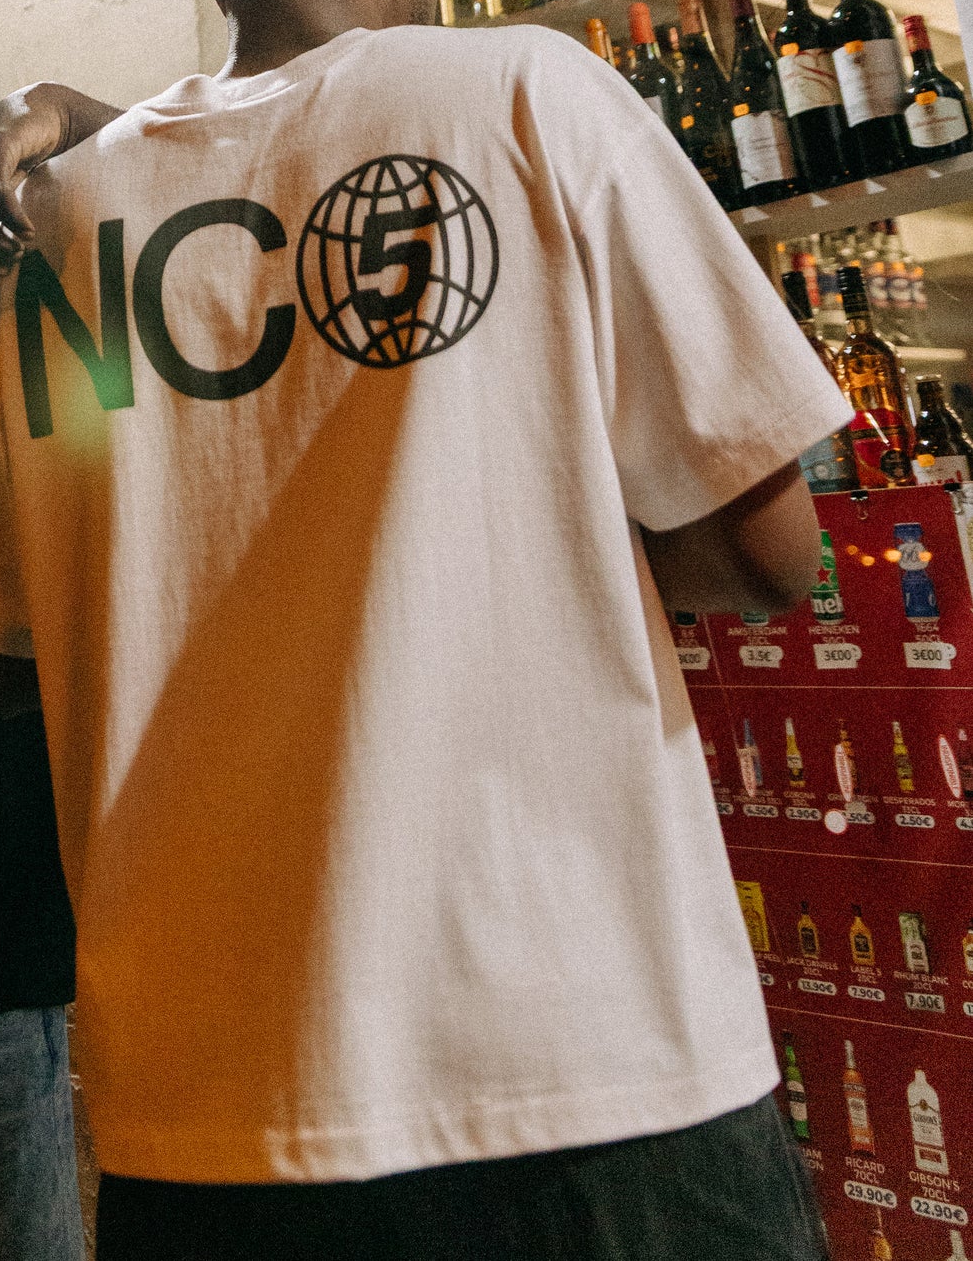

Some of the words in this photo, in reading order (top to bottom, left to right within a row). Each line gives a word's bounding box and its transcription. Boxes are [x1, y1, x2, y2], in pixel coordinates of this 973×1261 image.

[727, 626, 787, 636] AMSTERDAM
[807, 625, 860, 635] HEINEKEN
[747, 650, 771, 662] 3.5€
[824, 649, 852, 661] 3€00
[912, 649, 943, 661] 3€00
[883, 796, 936, 806] DESPERADOS
[900, 816, 931, 827] 2.50€
[850, 965, 875, 976] LABEL
[893, 970, 919, 981] RHUM
[921, 974, 949, 986] BLANC
[851, 987, 882, 1000] 7.90€
[908, 994, 942, 1009] 7.90€
[845, 1156, 885, 1174] RICARD
[854, 1169, 880, 1184] 70CL
[908, 1170, 960, 1191] GIBSON'S
[847, 1183, 894, 1206] 29.90€
[922, 1186, 949, 1202] 70CL
[914, 1199, 965, 1221] 22.90€
